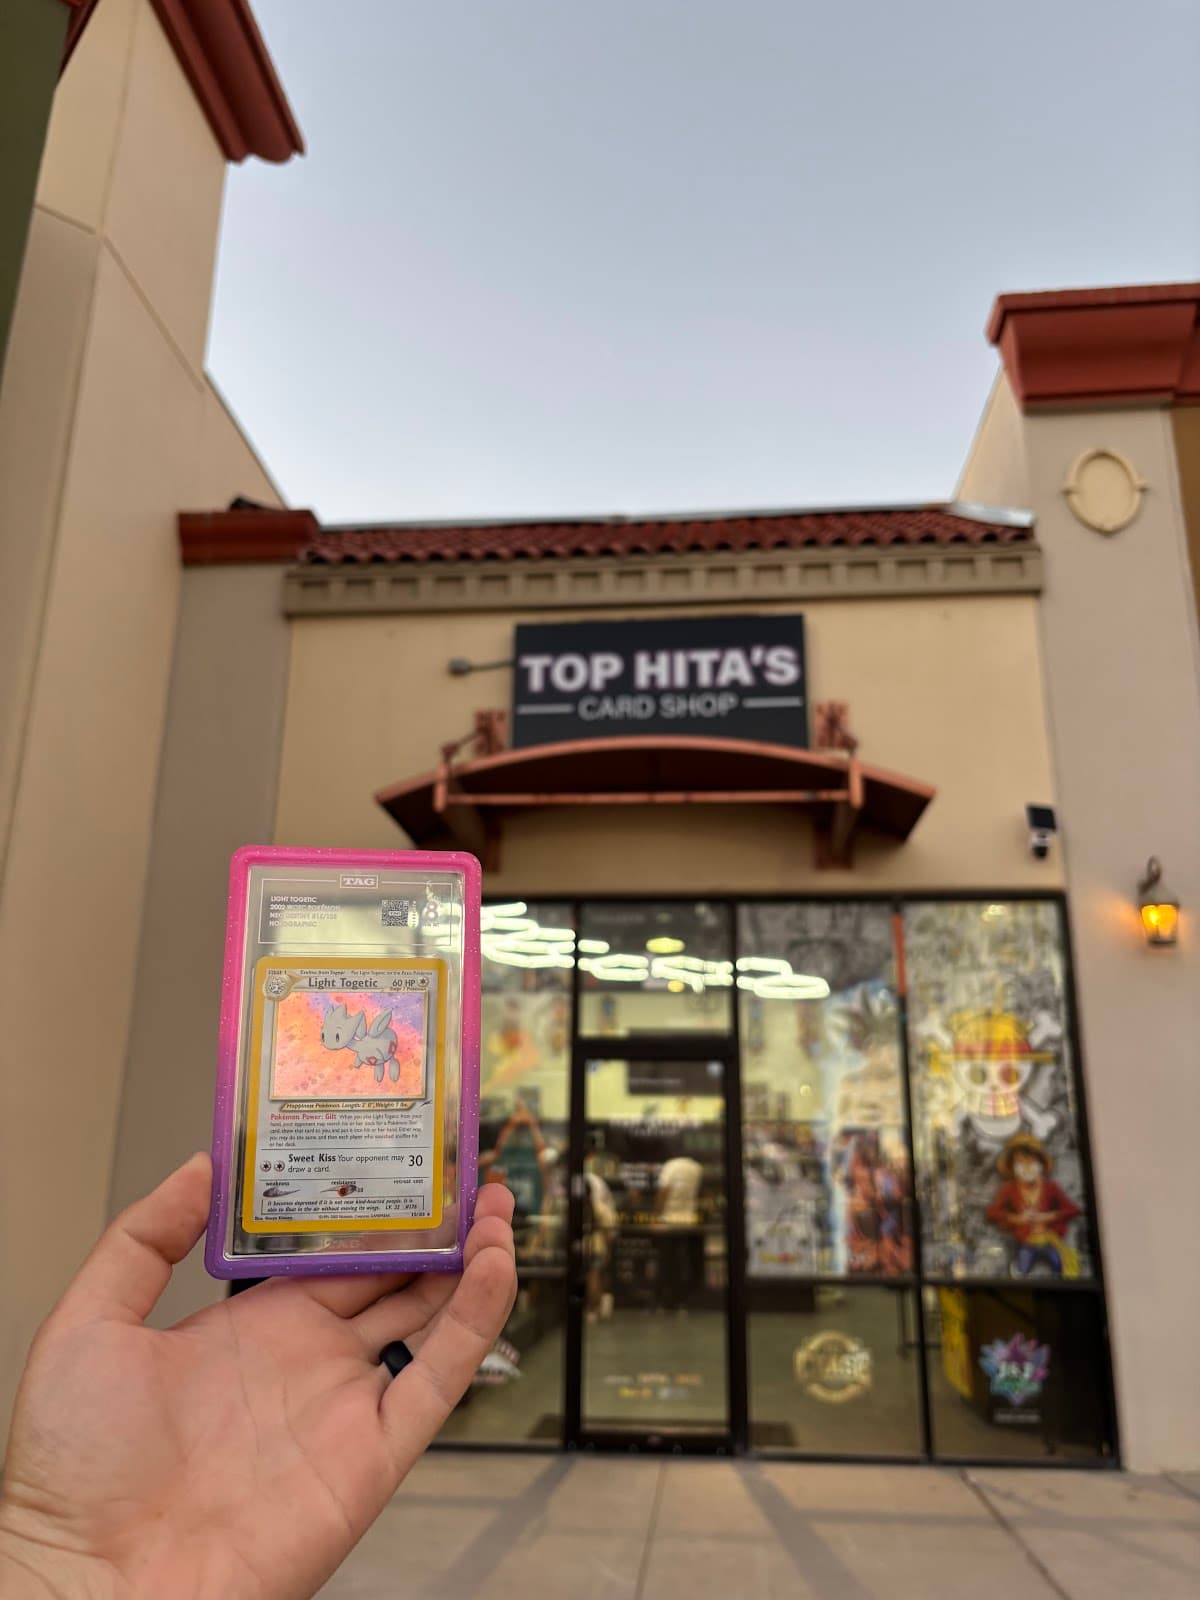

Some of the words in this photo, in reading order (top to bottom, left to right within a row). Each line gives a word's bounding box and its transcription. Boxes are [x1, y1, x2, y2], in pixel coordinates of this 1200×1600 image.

[519, 652, 624, 693] TOP
[634, 645, 799, 689] HITA'S
[578, 695, 655, 720] CARD
[660, 692, 738, 718] SHOP
[343, 878, 375, 886] TAG
[426, 901, 438, 921] 8
[308, 978, 336, 990] Light
[340, 978, 378, 990] Togetic
[288, 1154, 315, 1162] Sweet
[318, 1153, 336, 1162] Kiss
[356, 1155, 389, 1163] opponent
[408, 1154, 423, 1166] 30
